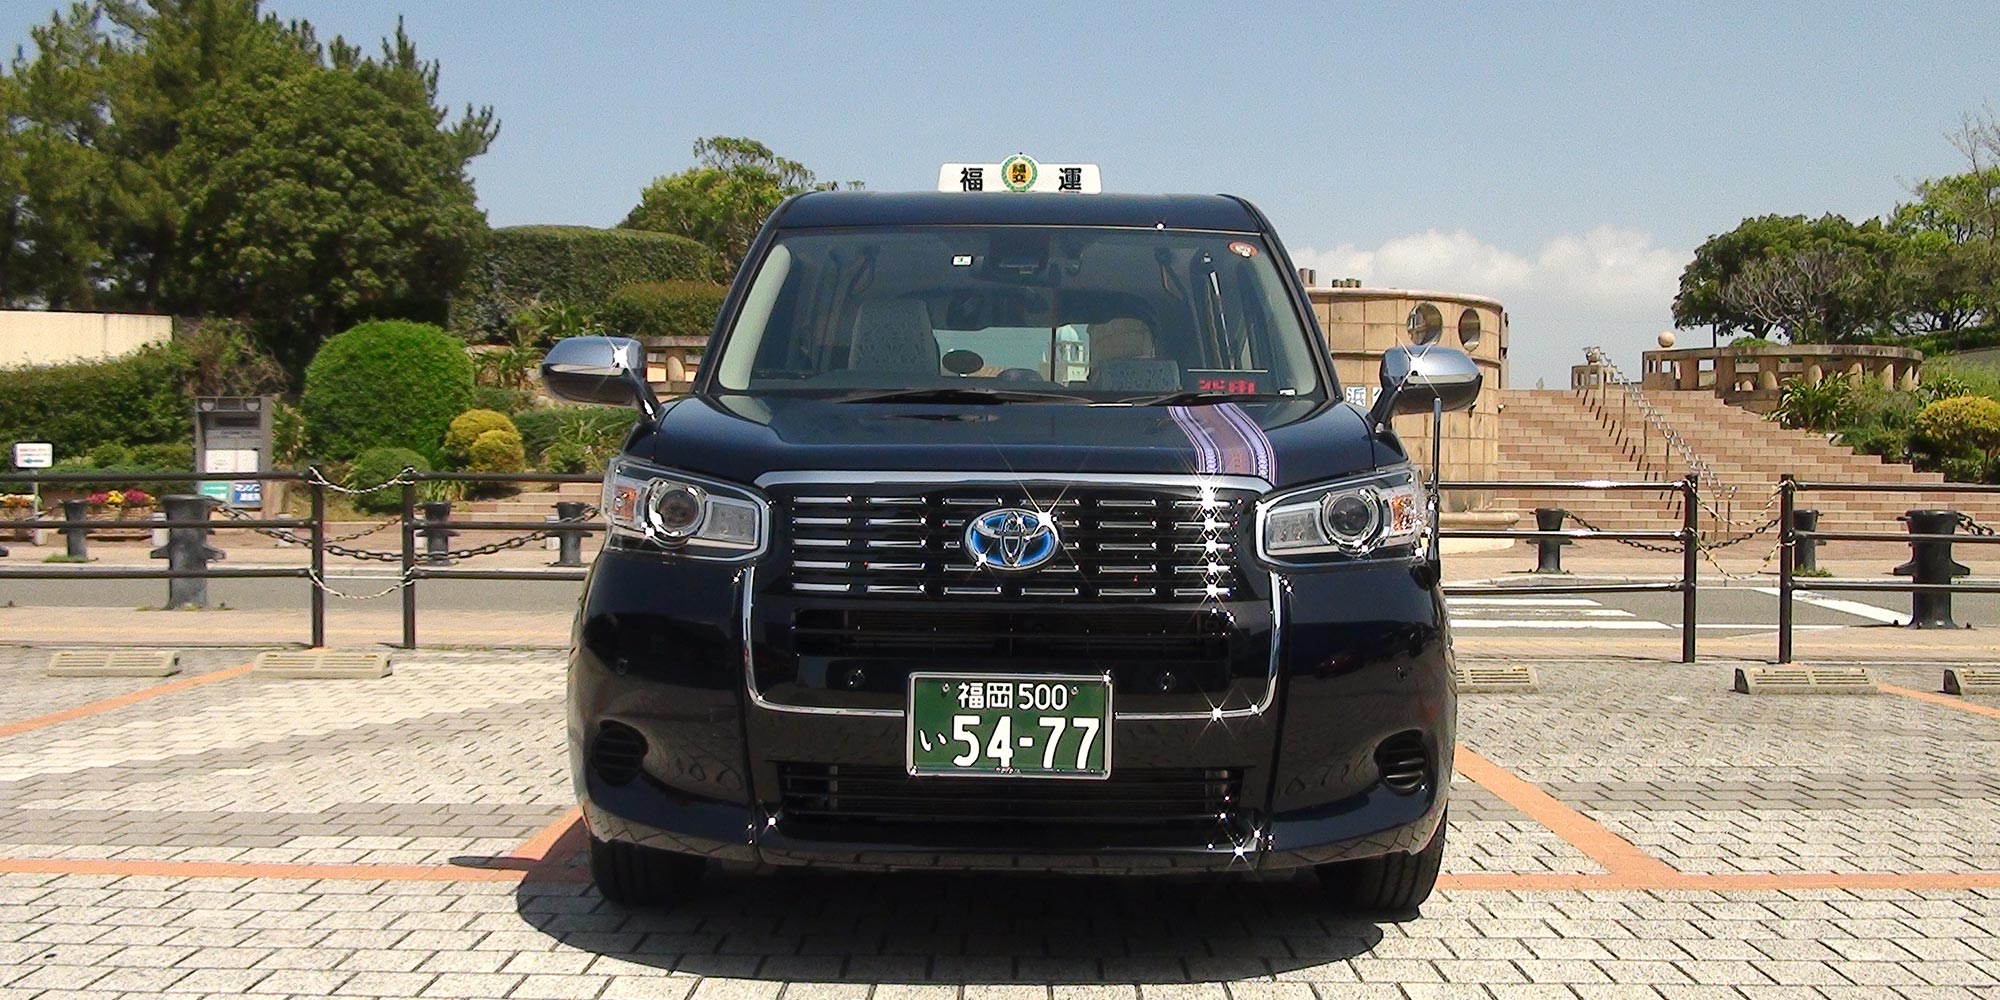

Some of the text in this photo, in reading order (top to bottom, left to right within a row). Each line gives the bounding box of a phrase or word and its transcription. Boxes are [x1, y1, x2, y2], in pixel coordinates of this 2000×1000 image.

[960, 167, 1082, 192] 福 運
[957, 682, 1068, 710] 福岡 500
[919, 715, 1100, 770] い 54-77
